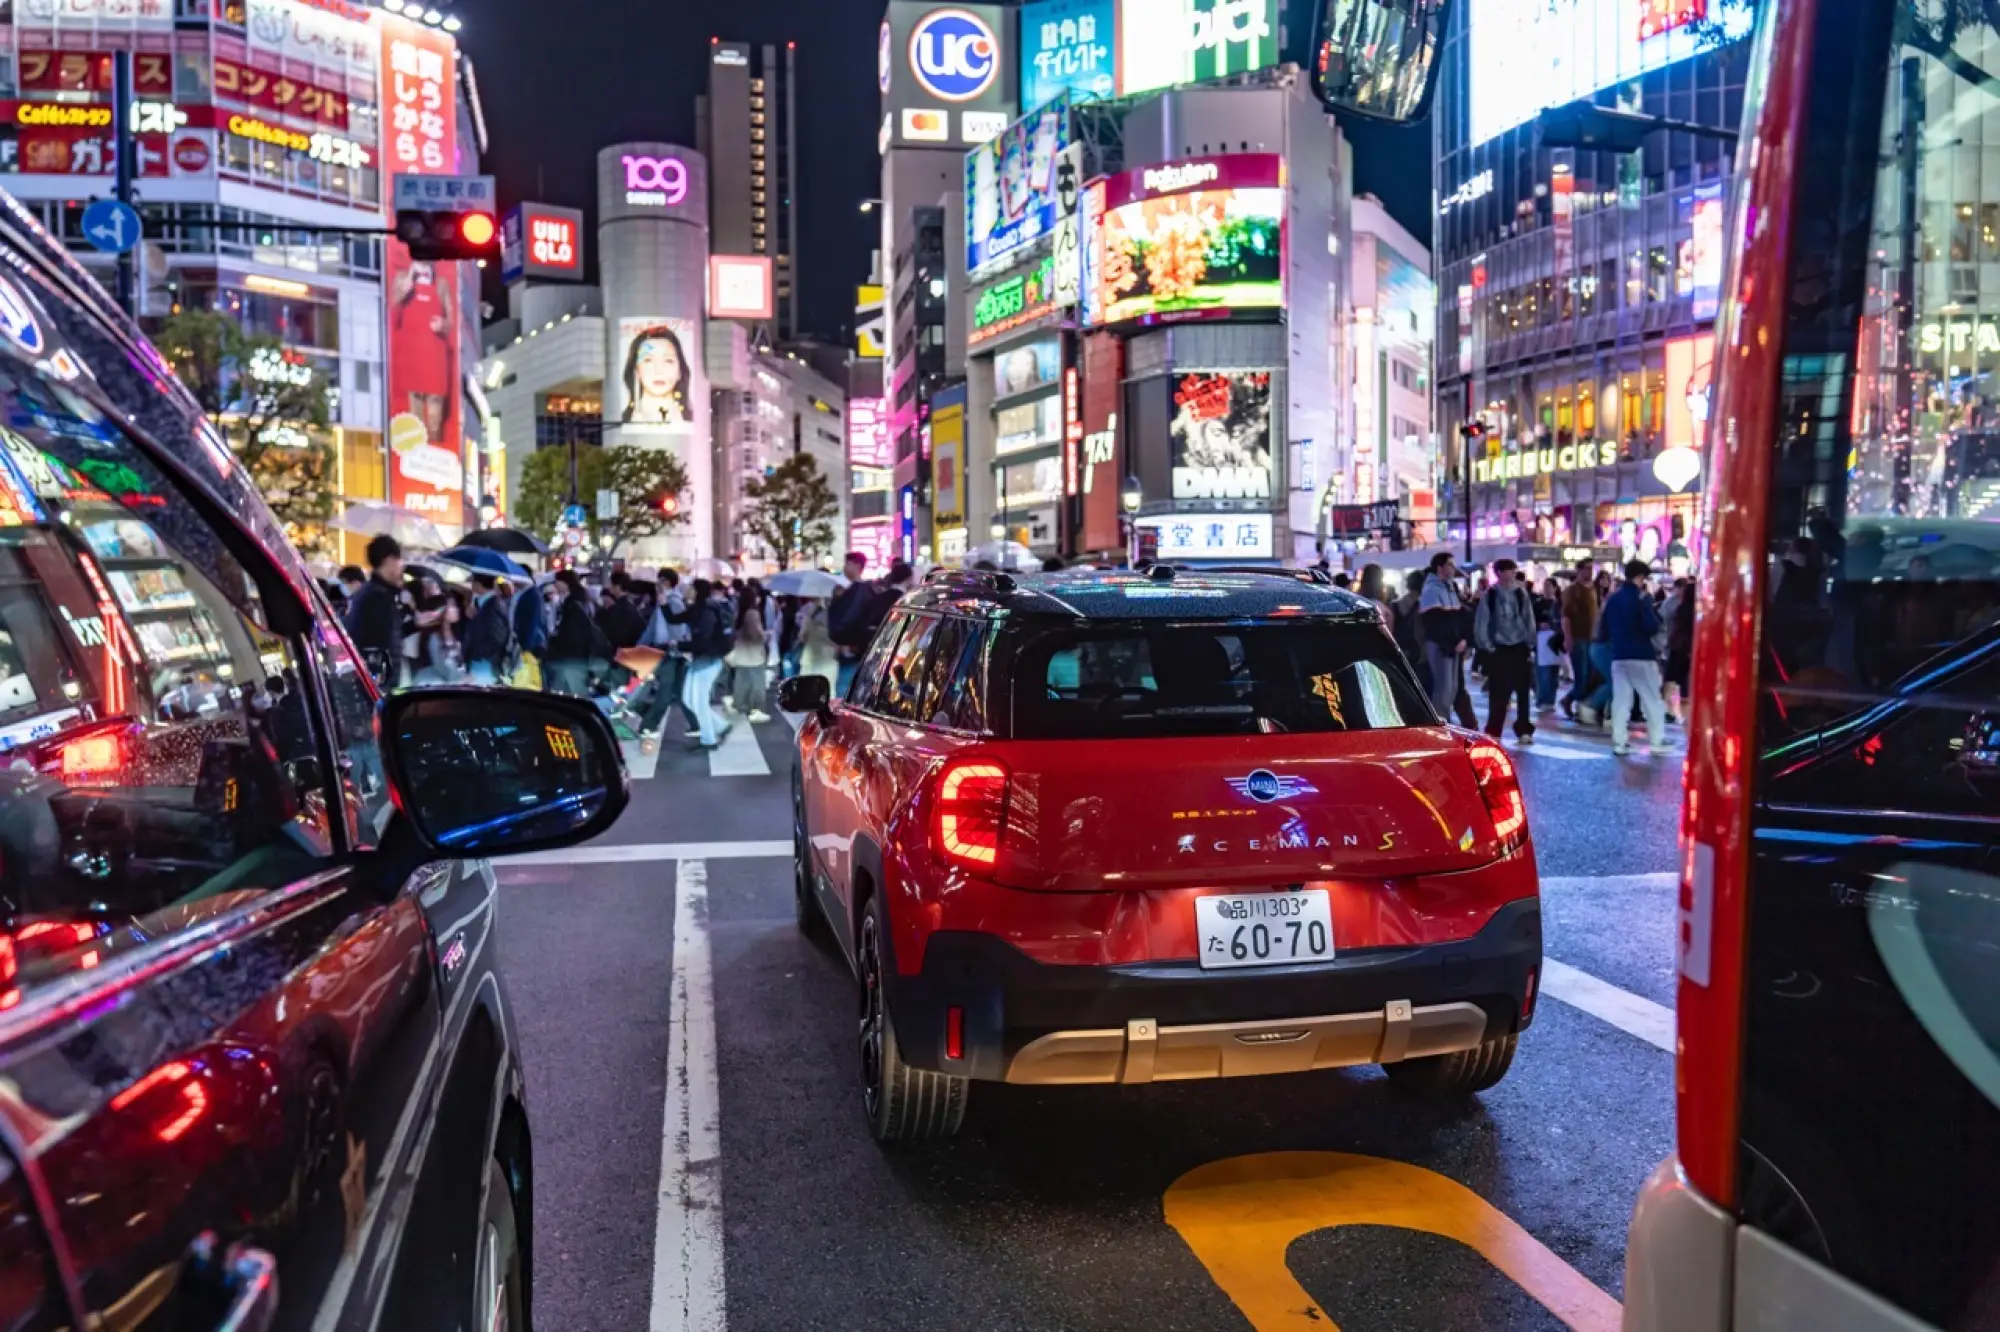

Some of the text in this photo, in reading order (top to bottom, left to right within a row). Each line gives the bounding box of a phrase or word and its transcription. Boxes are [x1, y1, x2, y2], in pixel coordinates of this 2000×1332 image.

[920, 33, 990, 77] UC
[215, 62, 343, 118] コンタクト
[130, 101, 188, 133] スト
[309, 132, 370, 169] ガスト
[622, 156, 686, 204] 109
[533, 220, 568, 242] UNI
[534, 241, 572, 263] QLO
[1470, 441, 1617, 484] TARBUCKS
[1157, 522, 1260, 548] 堂書店
[1179, 831, 1396, 852] ACEMAN S
[1230, 898, 1301, 919] 品川 303
[1208, 919, 1326, 960] た 60-70
